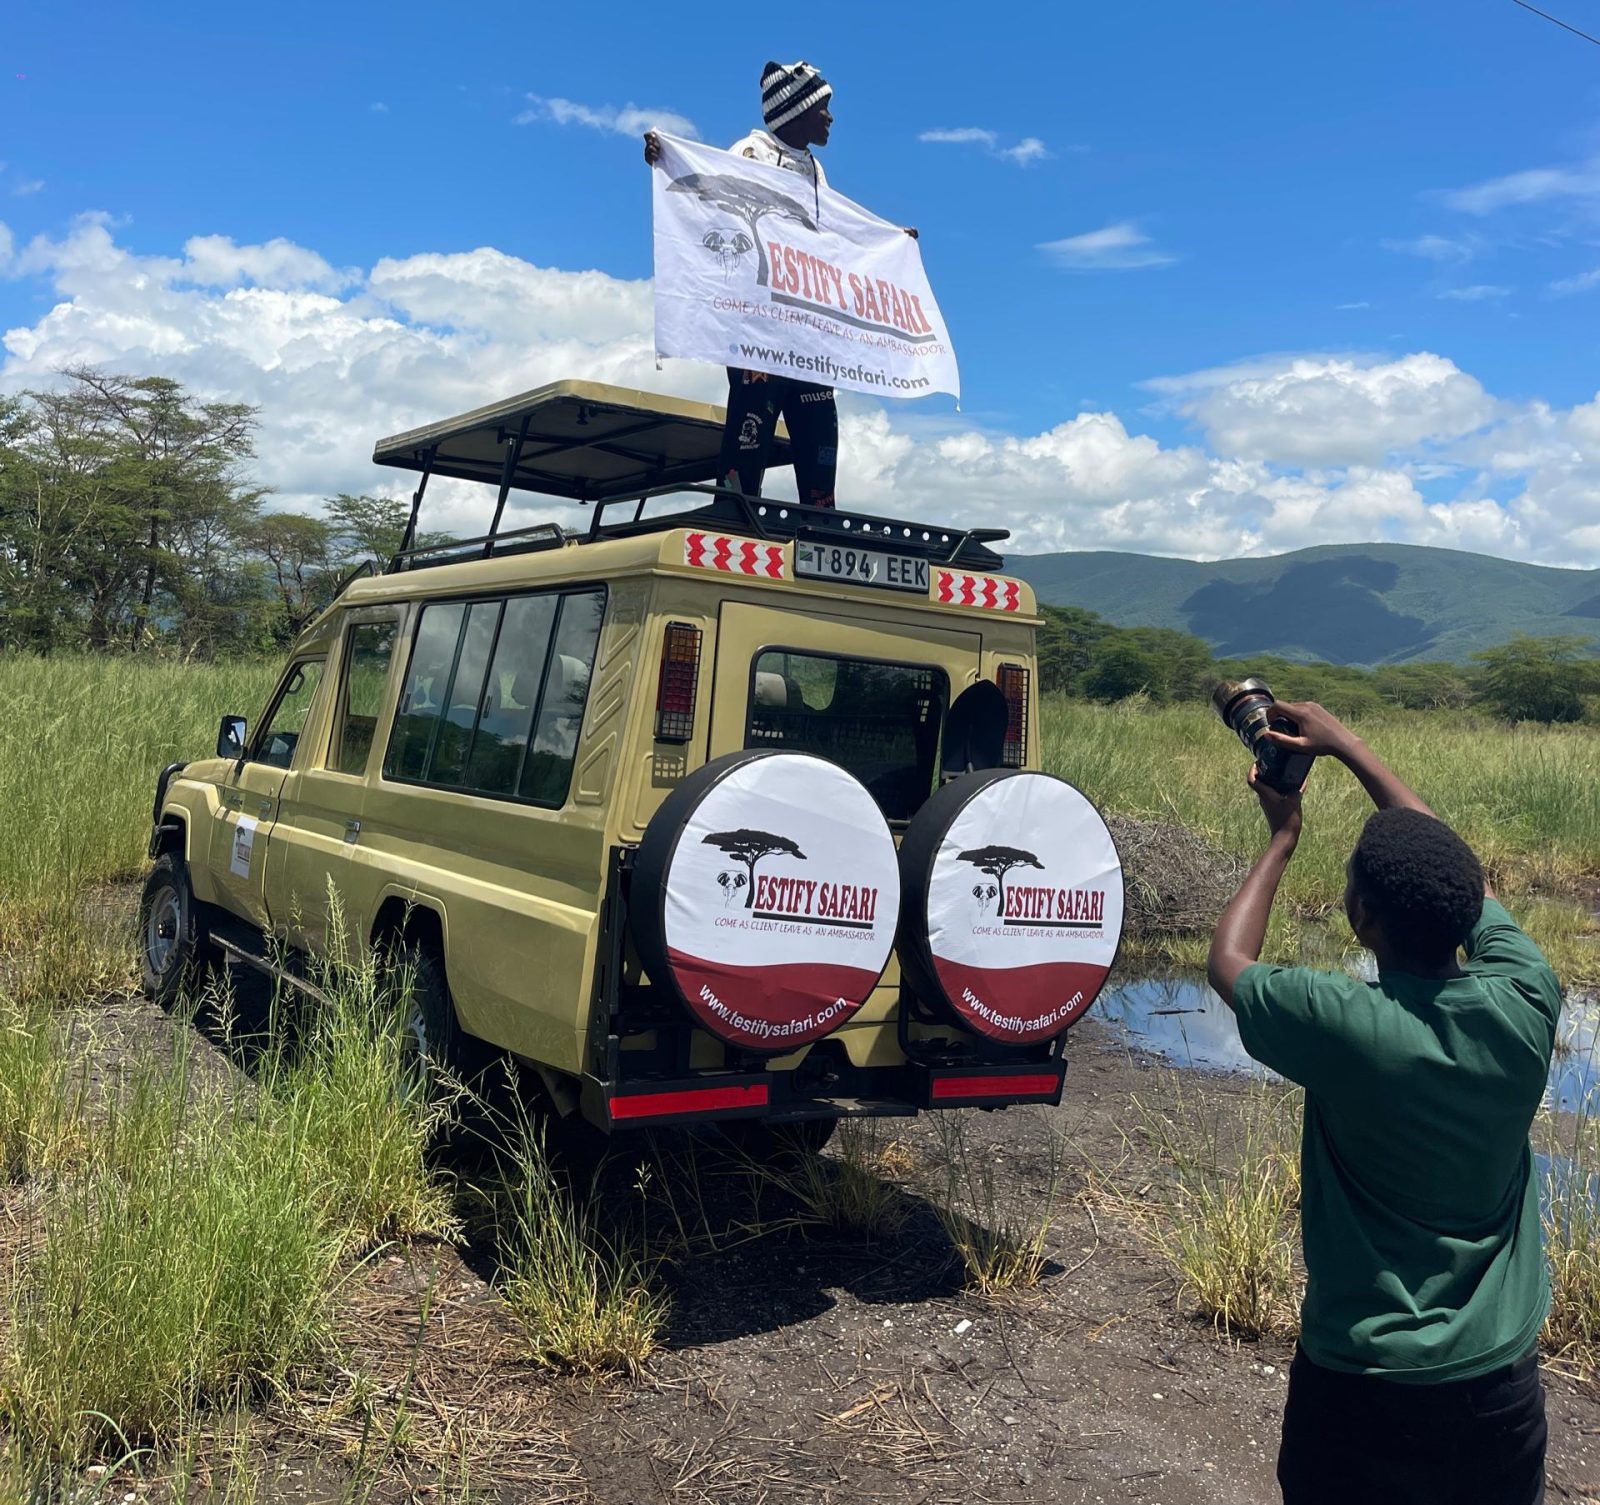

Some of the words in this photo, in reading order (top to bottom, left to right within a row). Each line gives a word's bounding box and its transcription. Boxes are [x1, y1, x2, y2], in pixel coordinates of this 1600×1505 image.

[848, 271, 932, 334] SAFARI
[713, 296, 750, 314] COME
[752, 303, 768, 318] AS
[770, 306, 811, 326] CLIENT
[812, 316, 840, 336] LEAVE
[842, 327, 854, 341] AS
[859, 332, 873, 346] AN
[875, 336, 946, 356] AMBASSADOR
[740, 343, 930, 390] www.testifysafari.com
[887, 556, 926, 586] EEK
[817, 882, 878, 921] SAFARI
[1056, 887, 1105, 921] SAFARI
[714, 916, 736, 928] COME
[739, 919, 750, 930] AS
[750, 920, 779, 932] CLIENT
[779, 924, 801, 934] LEAVE
[802, 926, 812, 935] AS
[815, 927, 827, 937] AN
[827, 929, 875, 941] AMBASSADOR
[972, 926, 991, 936] COME
[992, 926, 1002, 936] AS
[1002, 927, 1026, 937] CLIENT
[1026, 928, 1044, 938] LEAVE
[1045, 929, 1054, 938] AS
[1065, 929, 1105, 939] AMBASSADOR
[699, 984, 847, 1039] www.testifysafari.com
[962, 987, 1083, 1034] www.testifysafari.com
